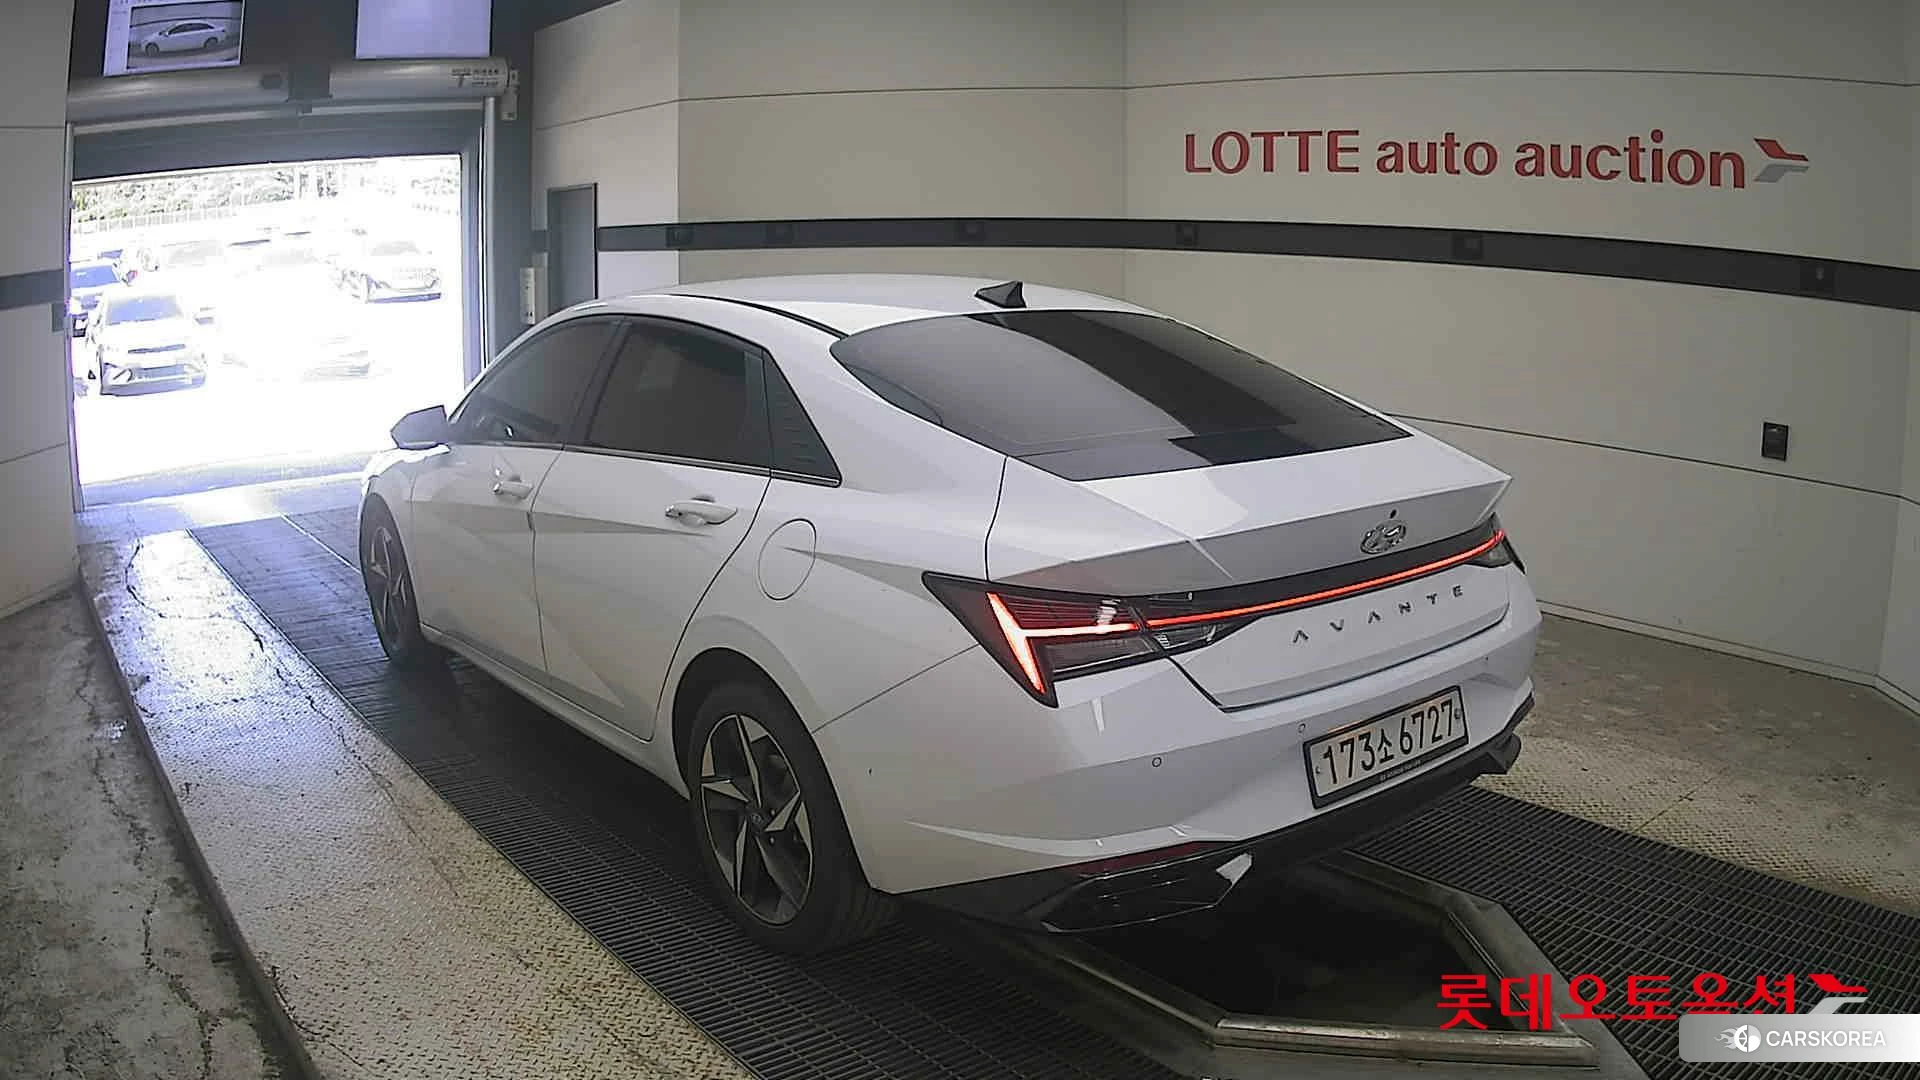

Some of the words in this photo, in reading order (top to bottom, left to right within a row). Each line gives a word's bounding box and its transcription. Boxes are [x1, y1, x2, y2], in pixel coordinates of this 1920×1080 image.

[1184, 129, 1360, 174] LOTTE
[1376, 131, 1498, 177] auto
[1514, 128, 1746, 189] auction
[1292, 585, 1465, 643] AVANTE
